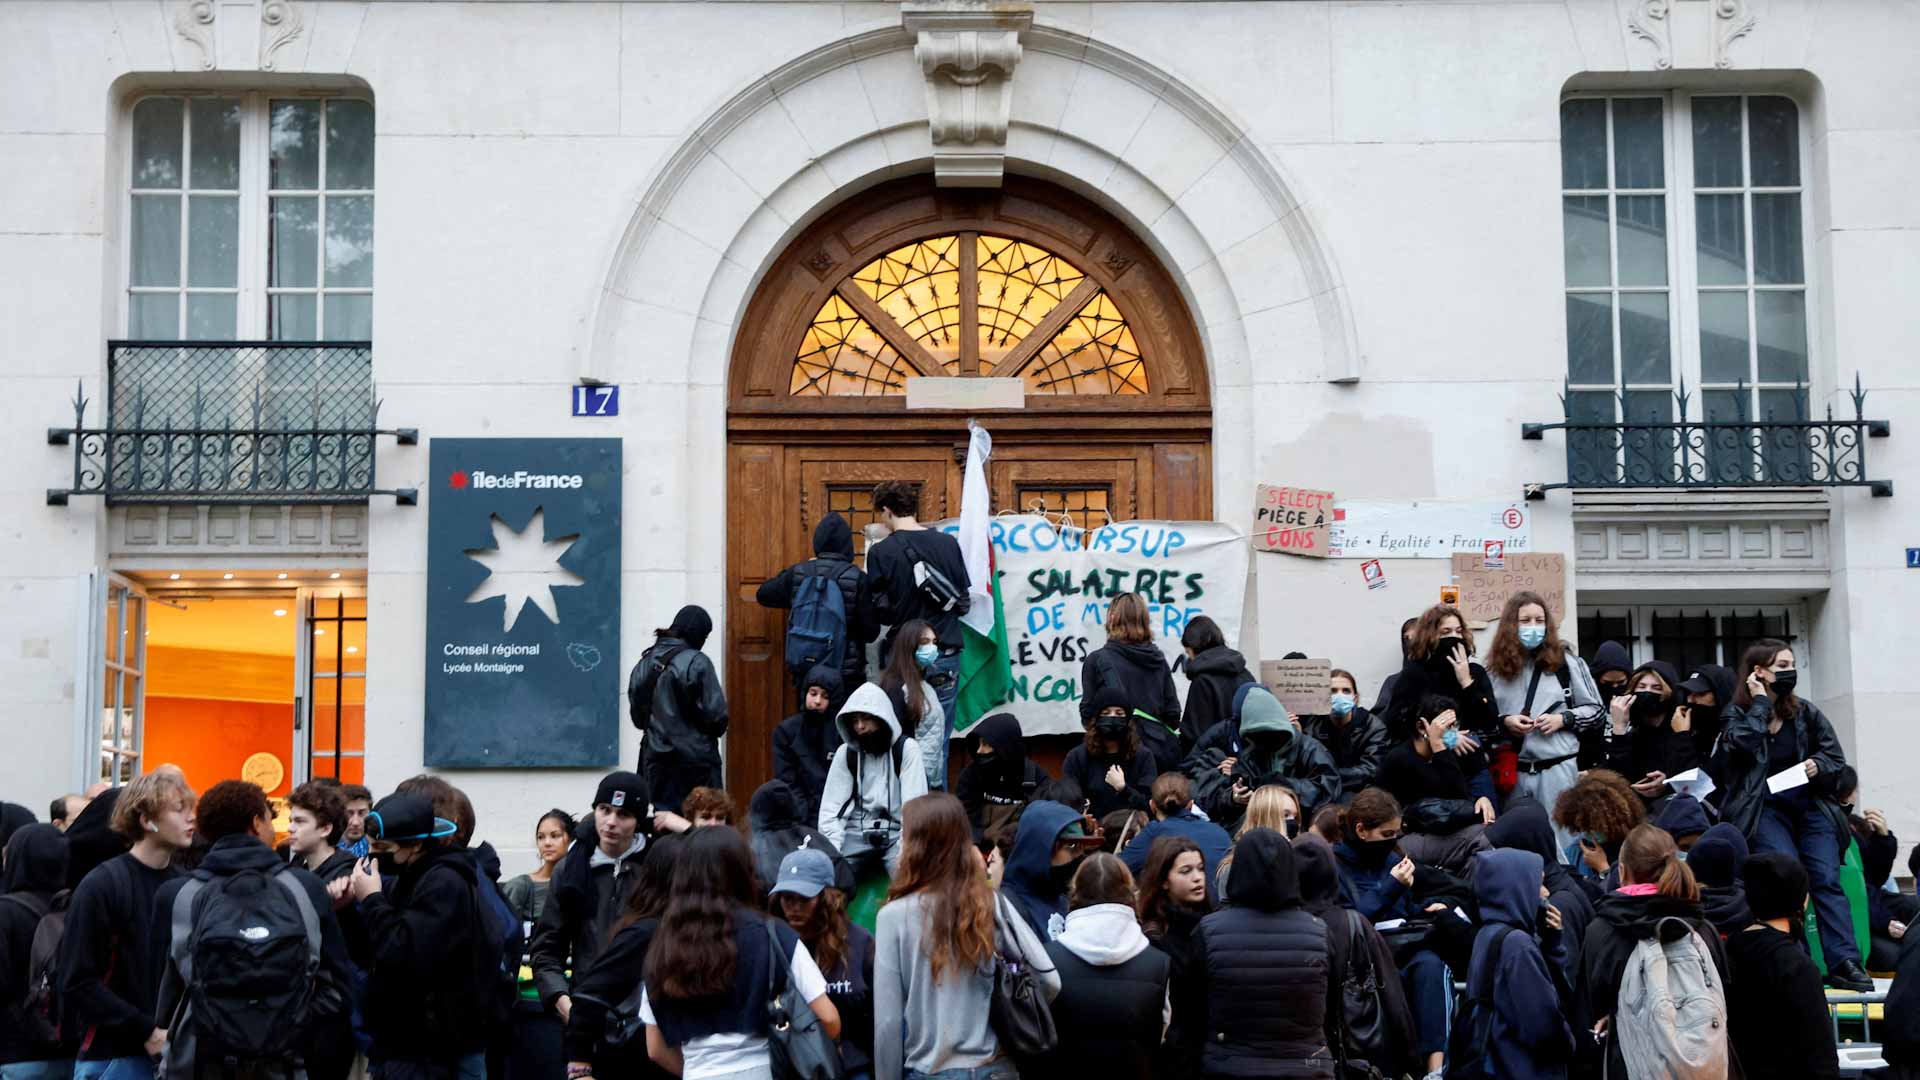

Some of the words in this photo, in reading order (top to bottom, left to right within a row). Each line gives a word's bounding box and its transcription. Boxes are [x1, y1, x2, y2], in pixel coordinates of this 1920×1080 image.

[577, 387, 614, 414] 17
[1257, 505, 1308, 526] PIÈGE
[1314, 508, 1326, 528] À
[1266, 526, 1316, 549] CONS
[1380, 531, 1432, 552] Égalité
[1452, 535, 1527, 549] Fratité
[1026, 568, 1204, 604] SALAIRES
[1027, 602, 1066, 637] DE
[443, 643, 489, 656] Conseil
[492, 643, 540, 658] régional
[443, 663, 472, 675] Lycée
[474, 663, 525, 675] Montaigne
[1034, 675, 1083, 703] COL
